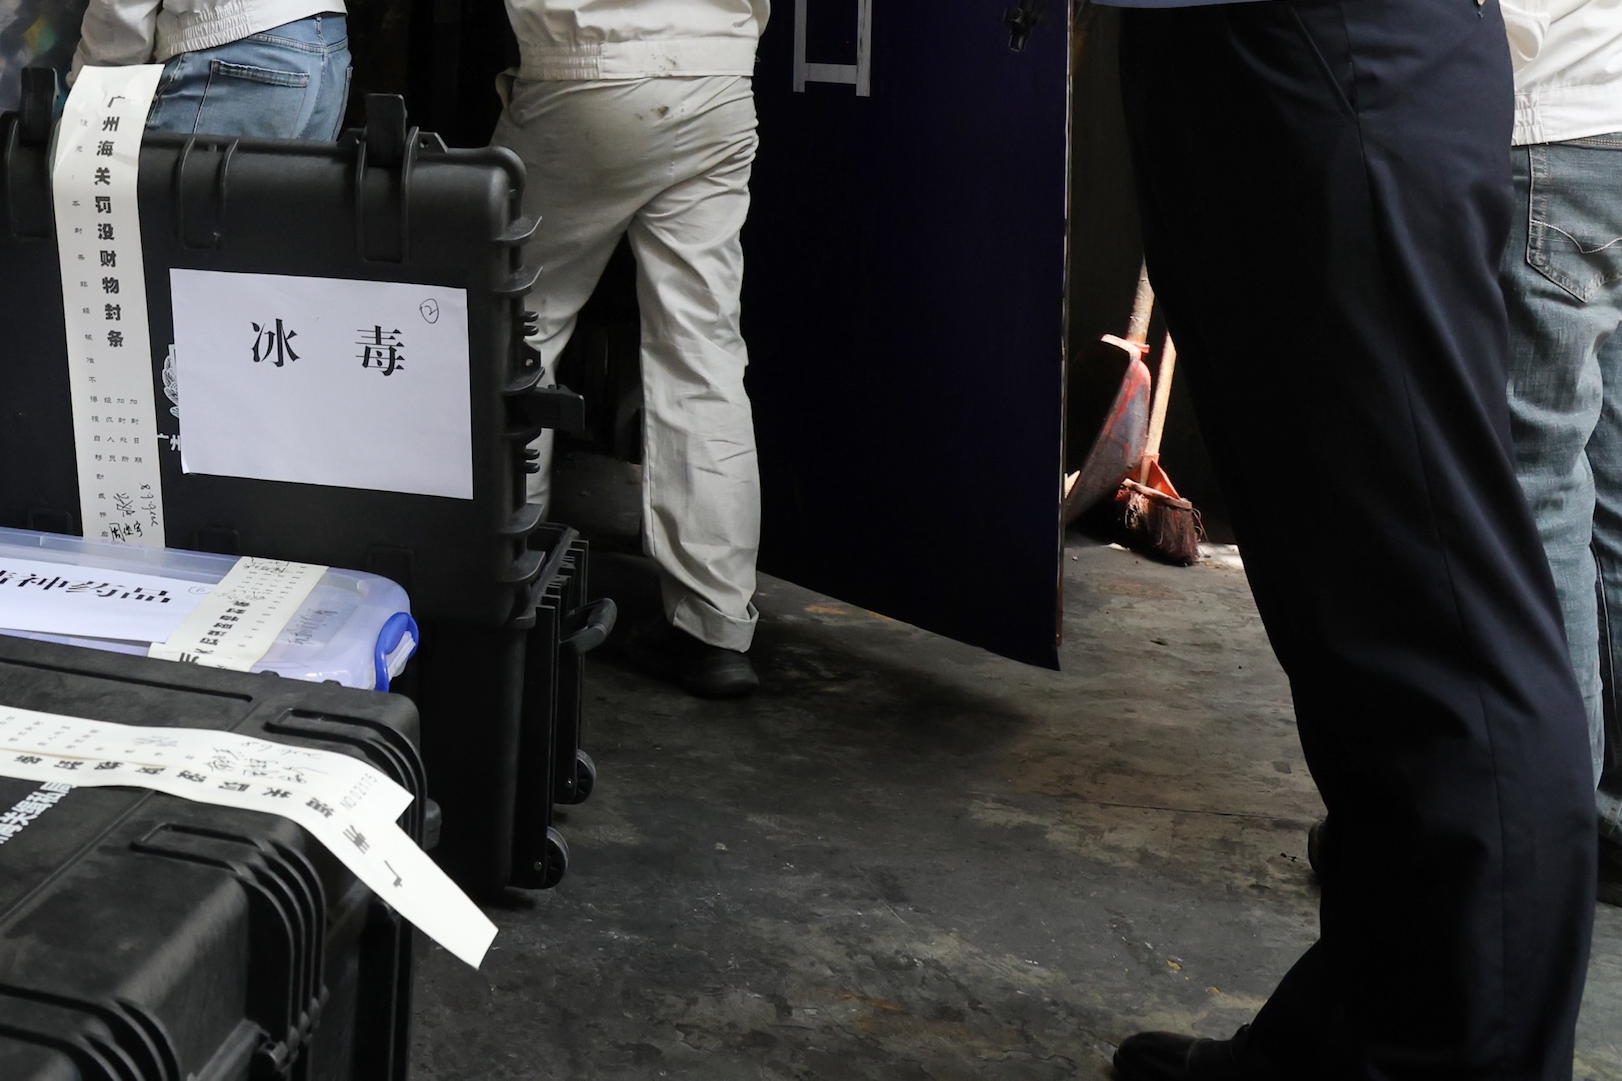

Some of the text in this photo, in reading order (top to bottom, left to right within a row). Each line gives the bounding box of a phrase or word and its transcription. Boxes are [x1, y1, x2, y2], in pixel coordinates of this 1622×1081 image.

[93, 95, 126, 348] 广州海关罚没财物封条
